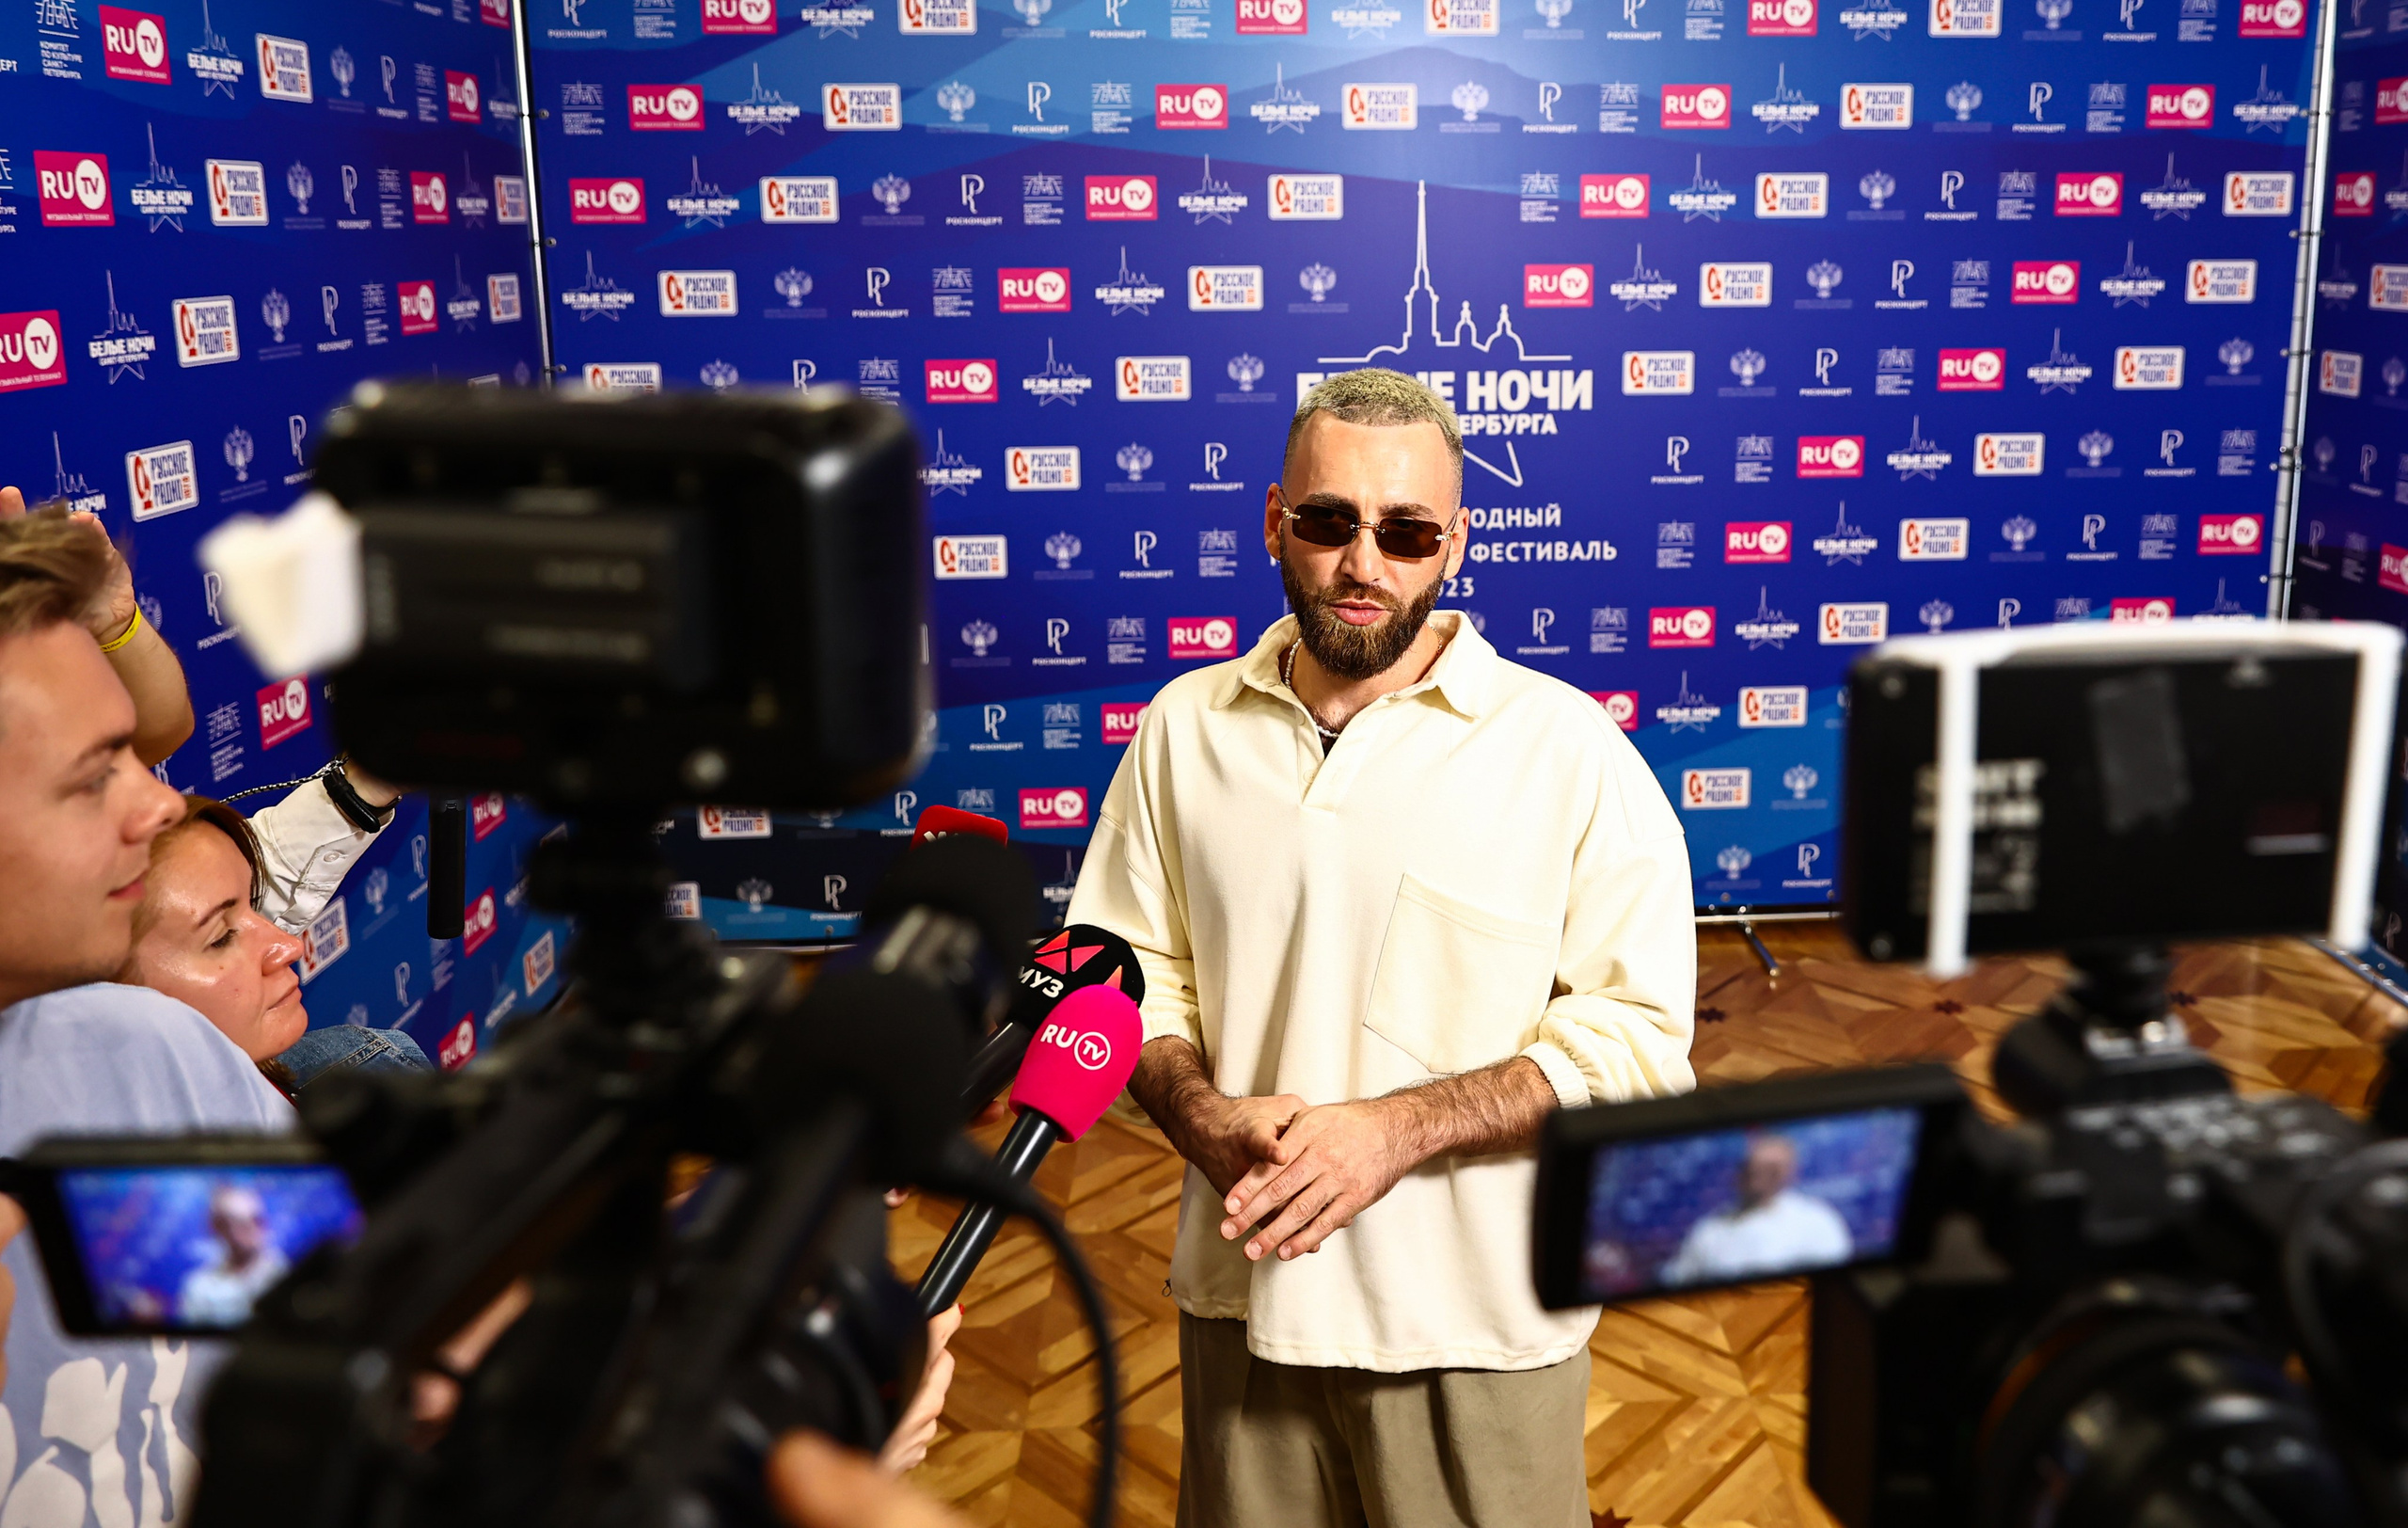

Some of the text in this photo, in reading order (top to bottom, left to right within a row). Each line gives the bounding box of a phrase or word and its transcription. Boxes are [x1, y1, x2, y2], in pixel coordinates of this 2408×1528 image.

[1466, 369, 1593, 411] НОЧИ
[1470, 503, 1561, 530] ОДНЫЙ
[1469, 540, 1617, 564] ФЕСТИВАЛЬ
[1439, 577, 1475, 597] 23
